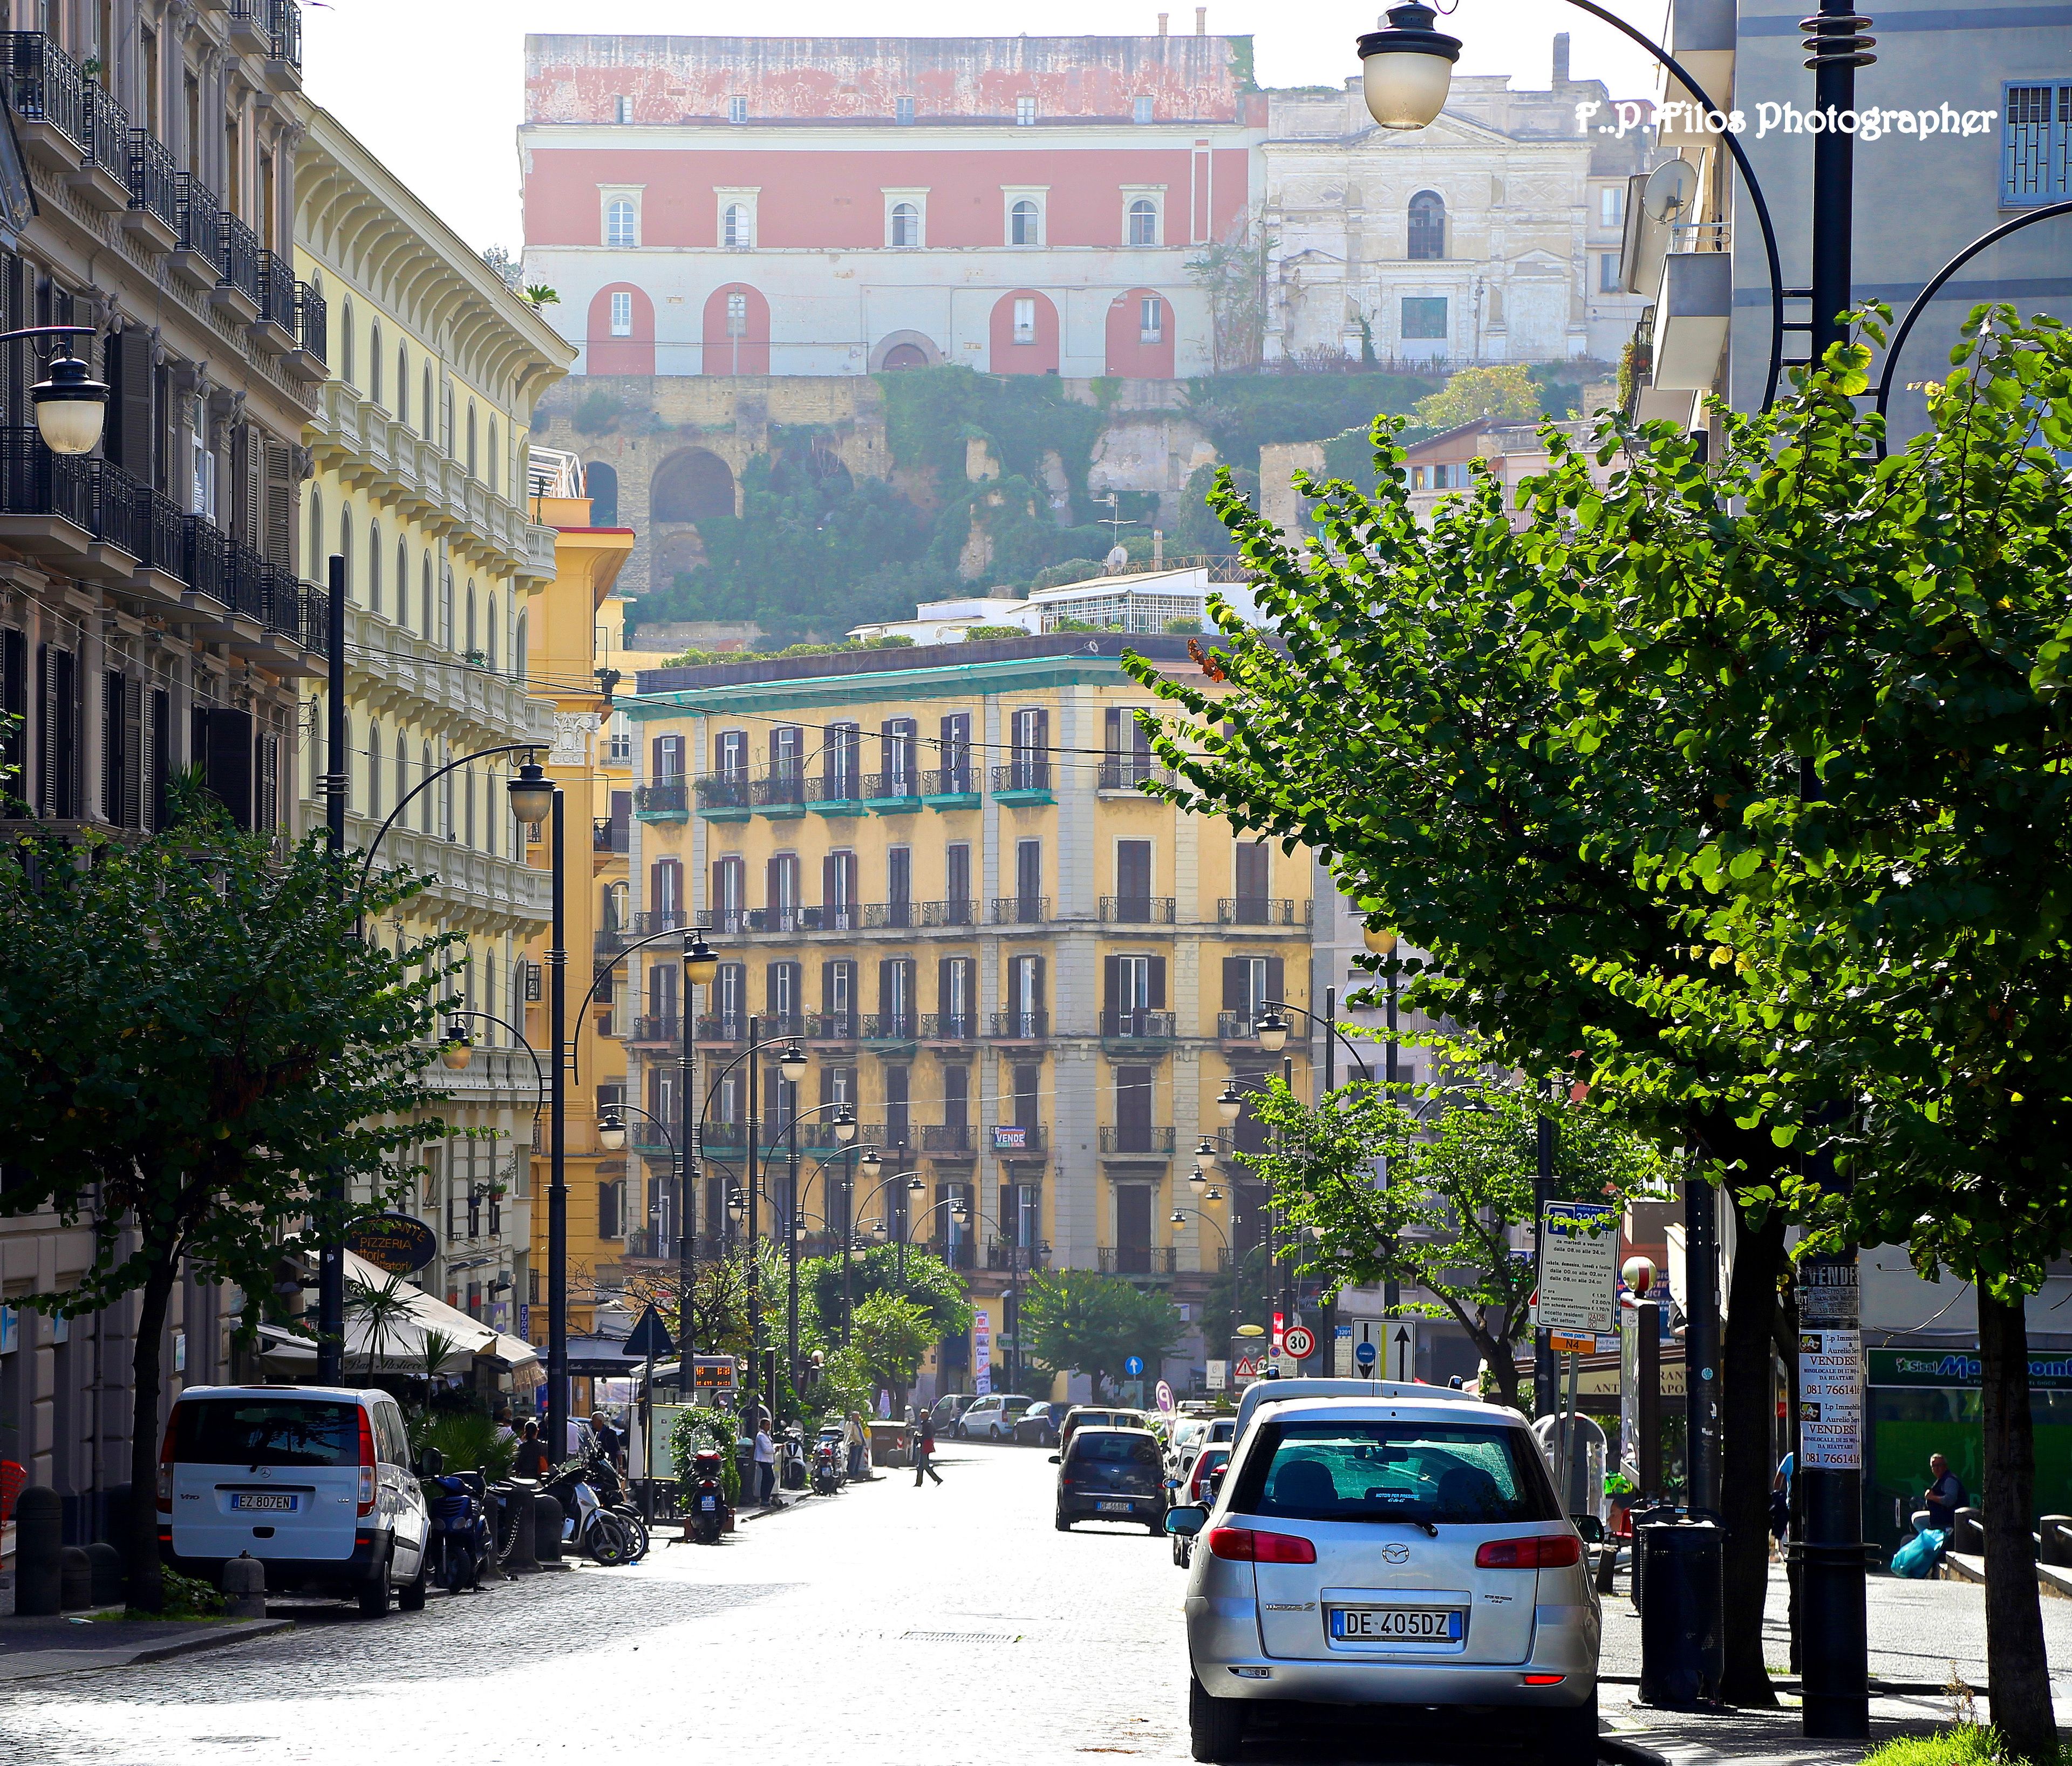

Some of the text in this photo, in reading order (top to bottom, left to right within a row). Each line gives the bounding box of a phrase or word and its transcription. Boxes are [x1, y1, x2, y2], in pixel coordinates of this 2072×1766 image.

[997, 1133, 1025, 1142] VENDE
[360, 1238, 412, 1250] PIZZERIA
[1290, 1335, 1306, 1349] 30
[1565, 1339, 1579, 1349] N4
[1810, 1356, 1857, 1366] VENDESI
[1807, 1384, 1822, 1394] 081
[1825, 1403, 1834, 1411] Lp
[1809, 1424, 1857, 1435] VENDESI
[1805, 1452, 1860, 1464] 081 7661416
[240, 1496, 253, 1507] EZ
[256, 1497, 290, 1508] 807EN
[1347, 1613, 1372, 1634] DE
[1380, 1613, 1448, 1635] 405DZ
